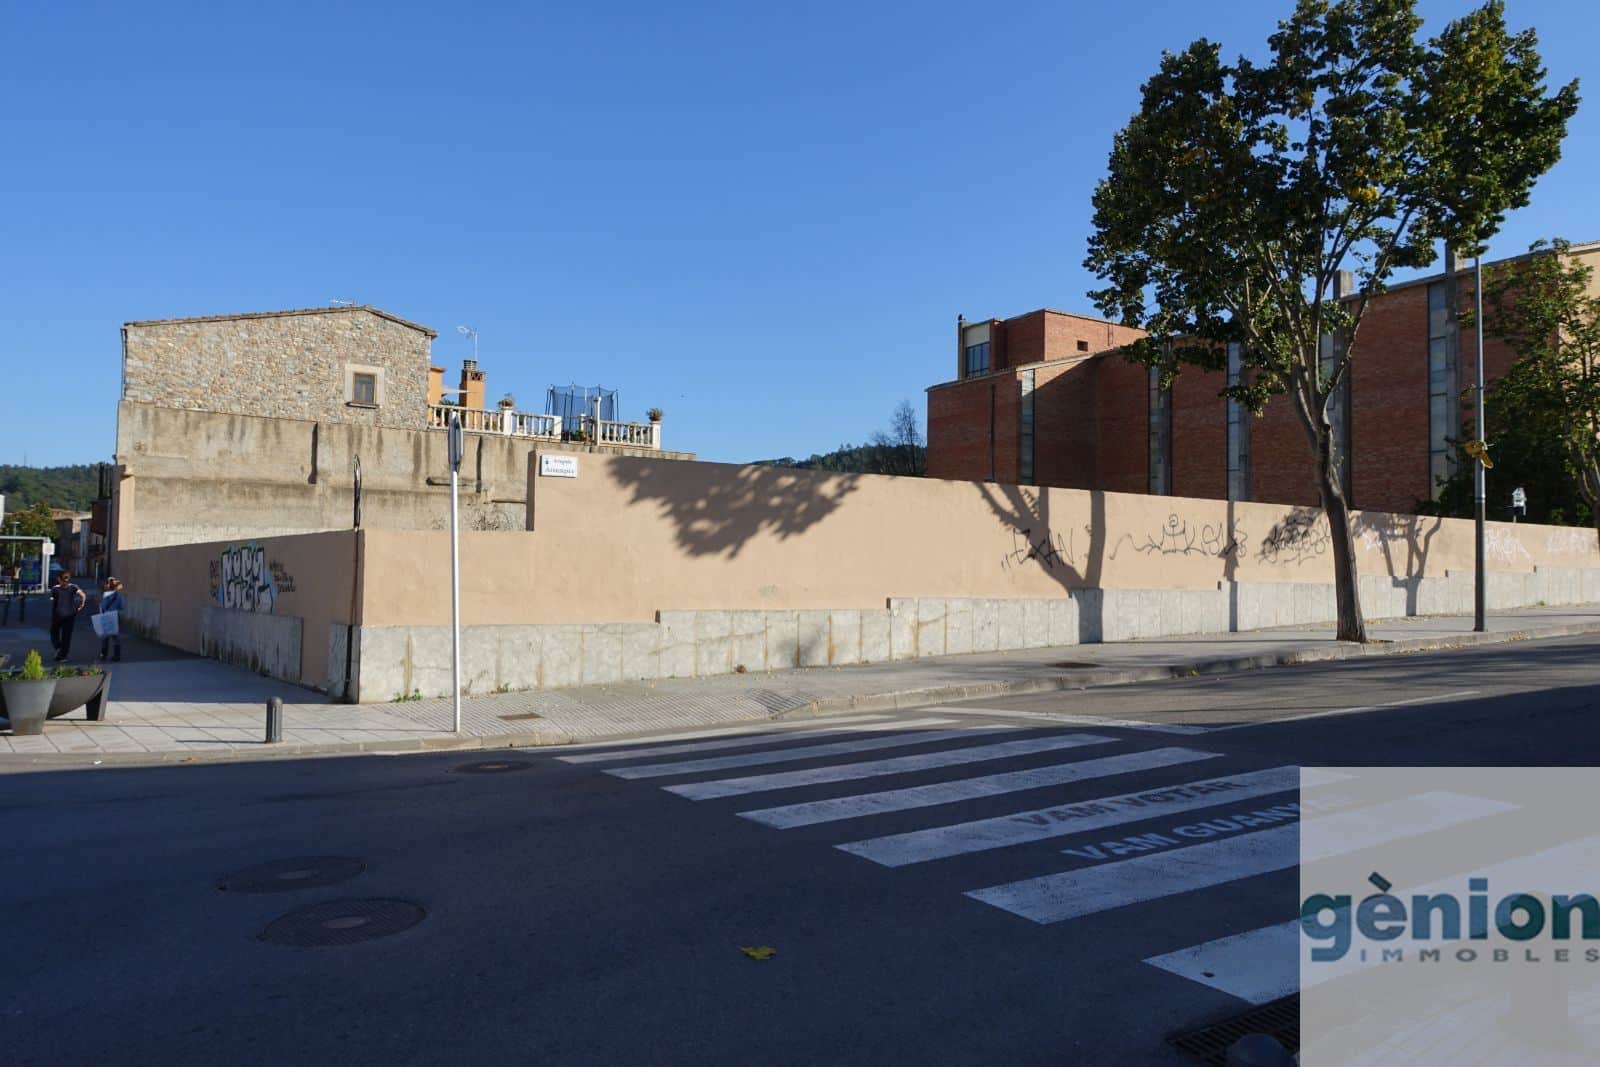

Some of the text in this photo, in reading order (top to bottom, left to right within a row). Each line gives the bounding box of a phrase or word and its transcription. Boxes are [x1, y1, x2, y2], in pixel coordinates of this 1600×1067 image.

[1010, 780, 1247, 825] VAM VOTAR
[1060, 833, 1181, 860] VAM
